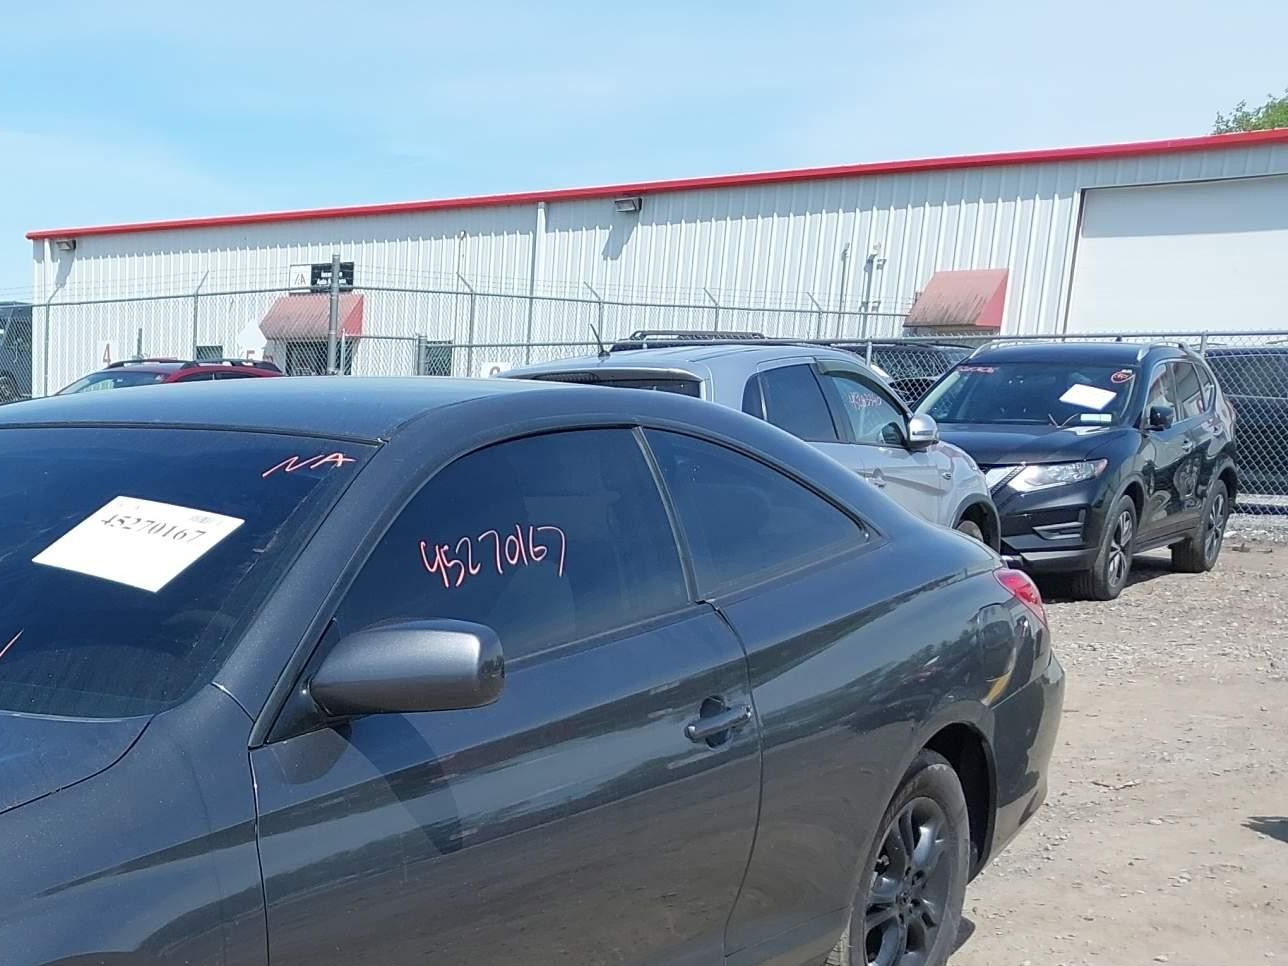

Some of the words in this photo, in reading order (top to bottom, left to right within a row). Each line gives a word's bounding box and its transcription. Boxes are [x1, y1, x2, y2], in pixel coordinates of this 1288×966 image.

[261, 452, 357, 478] NA
[99, 513, 208, 543] 45270167
[419, 523, 567, 588] 45270167
